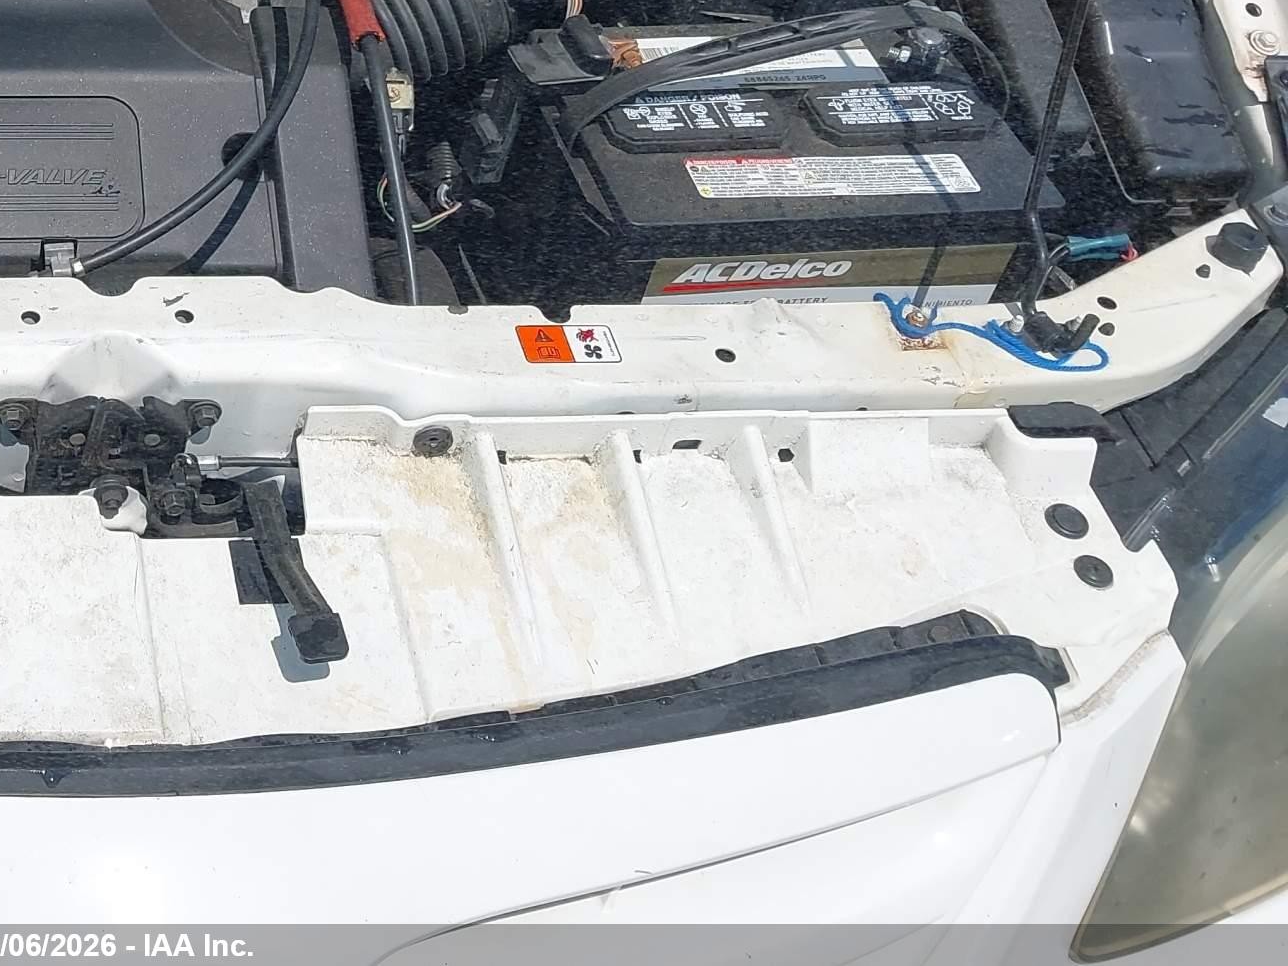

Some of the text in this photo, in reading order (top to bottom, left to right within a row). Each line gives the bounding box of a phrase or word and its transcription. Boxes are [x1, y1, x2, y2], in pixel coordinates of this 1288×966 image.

[646, 95, 689, 103] DANGER
[700, 93, 740, 101] POISON
[671, 258, 852, 284] ACDelco
[925, 299, 973, 307] NIMIENTO
